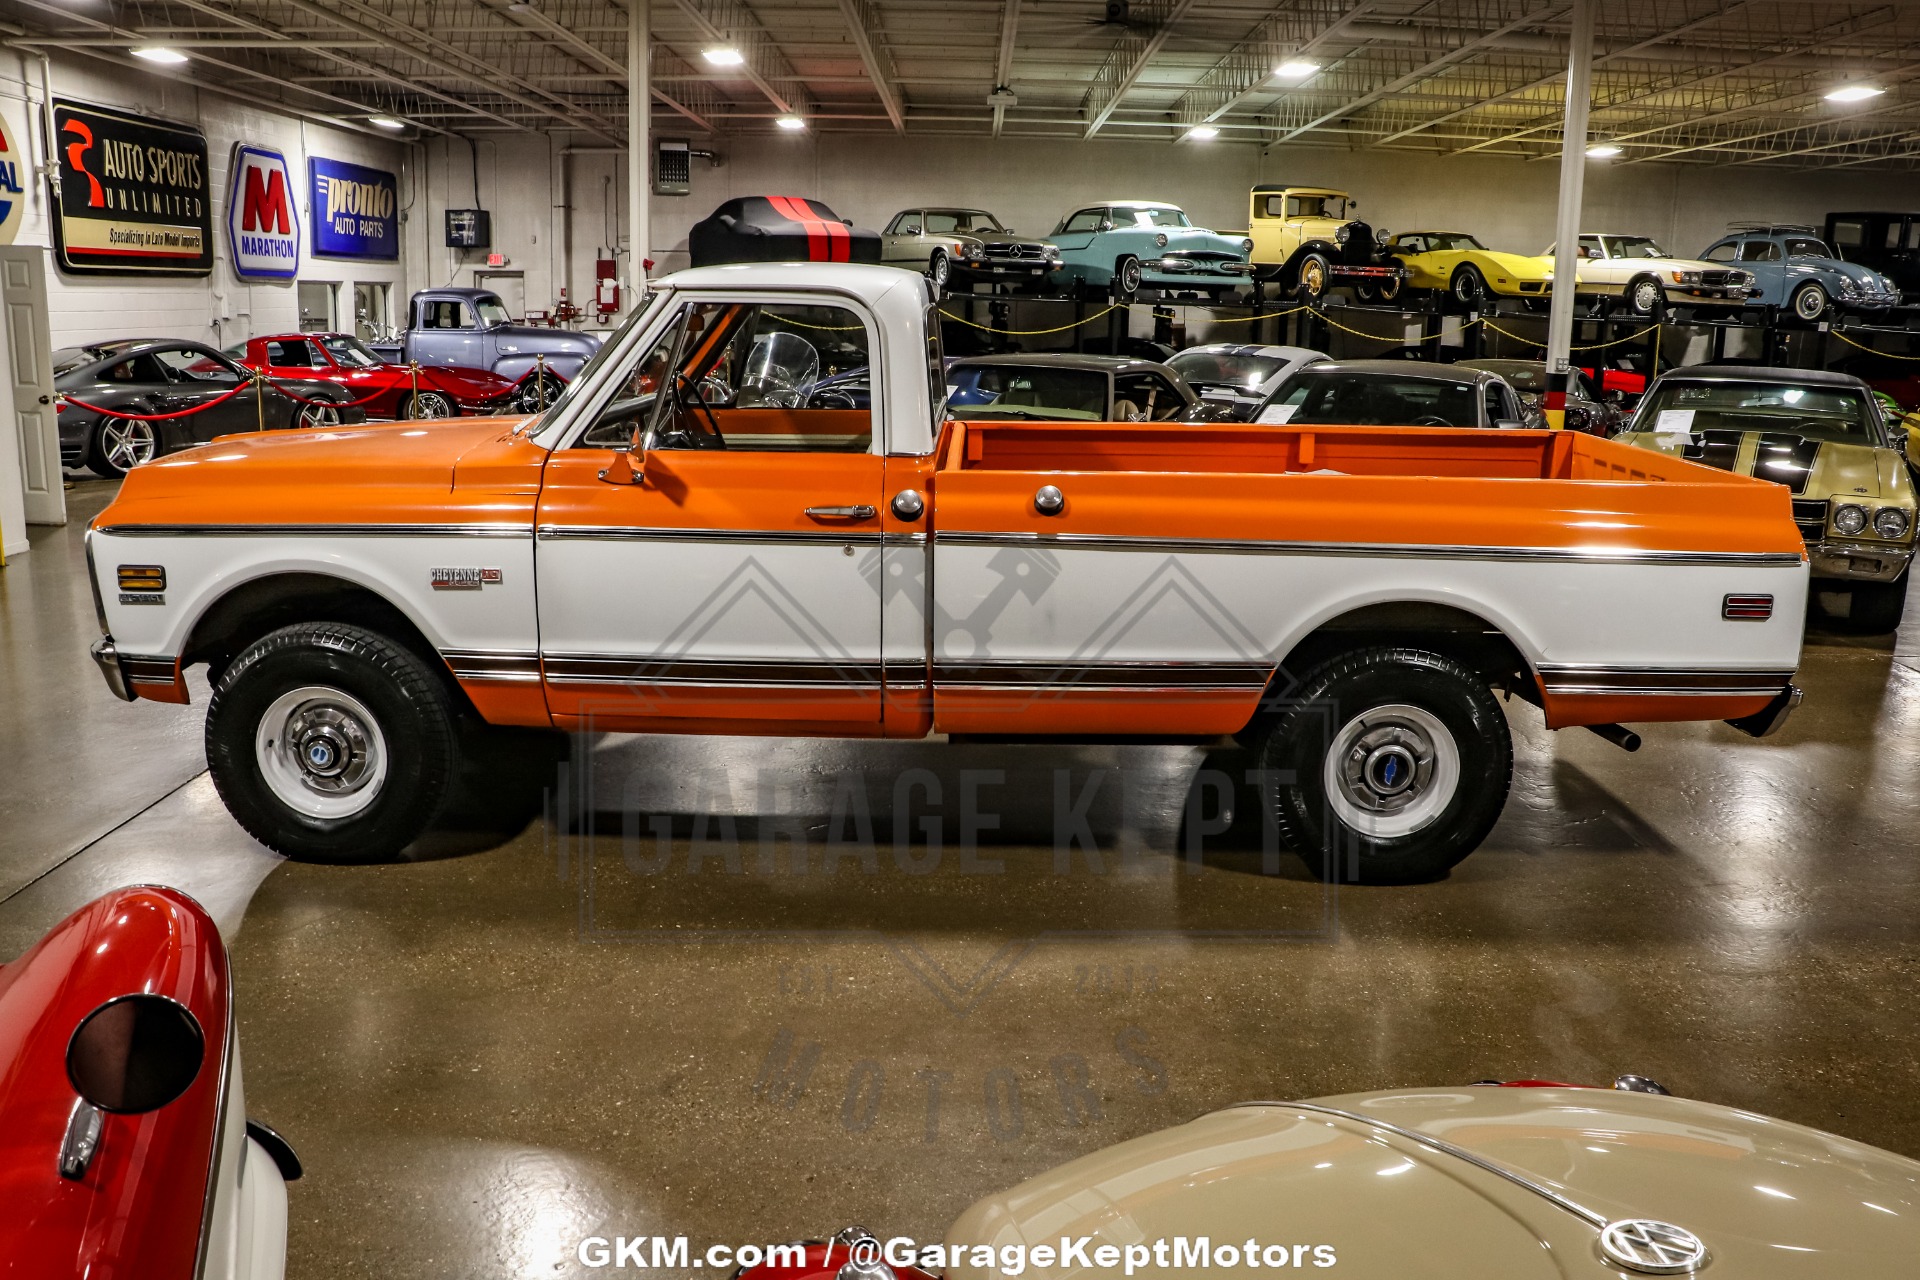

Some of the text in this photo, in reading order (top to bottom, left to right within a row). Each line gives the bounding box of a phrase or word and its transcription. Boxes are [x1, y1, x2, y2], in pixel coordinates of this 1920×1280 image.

[103, 139, 201, 190] AUTO SPORTS
[105, 187, 201, 218] UNLIMITED
[242, 165, 290, 235] M
[326, 177, 394, 222] pronto
[109, 228, 144, 246] Specializing
[152, 231, 164, 245] Late
[164, 231, 180, 247] Model
[181, 232, 200, 249] Imports
[334, 217, 384, 239] AUTO PARTS
[241, 236, 294, 258] MARATHON
[430, 567, 480, 581] CHEYENNE
